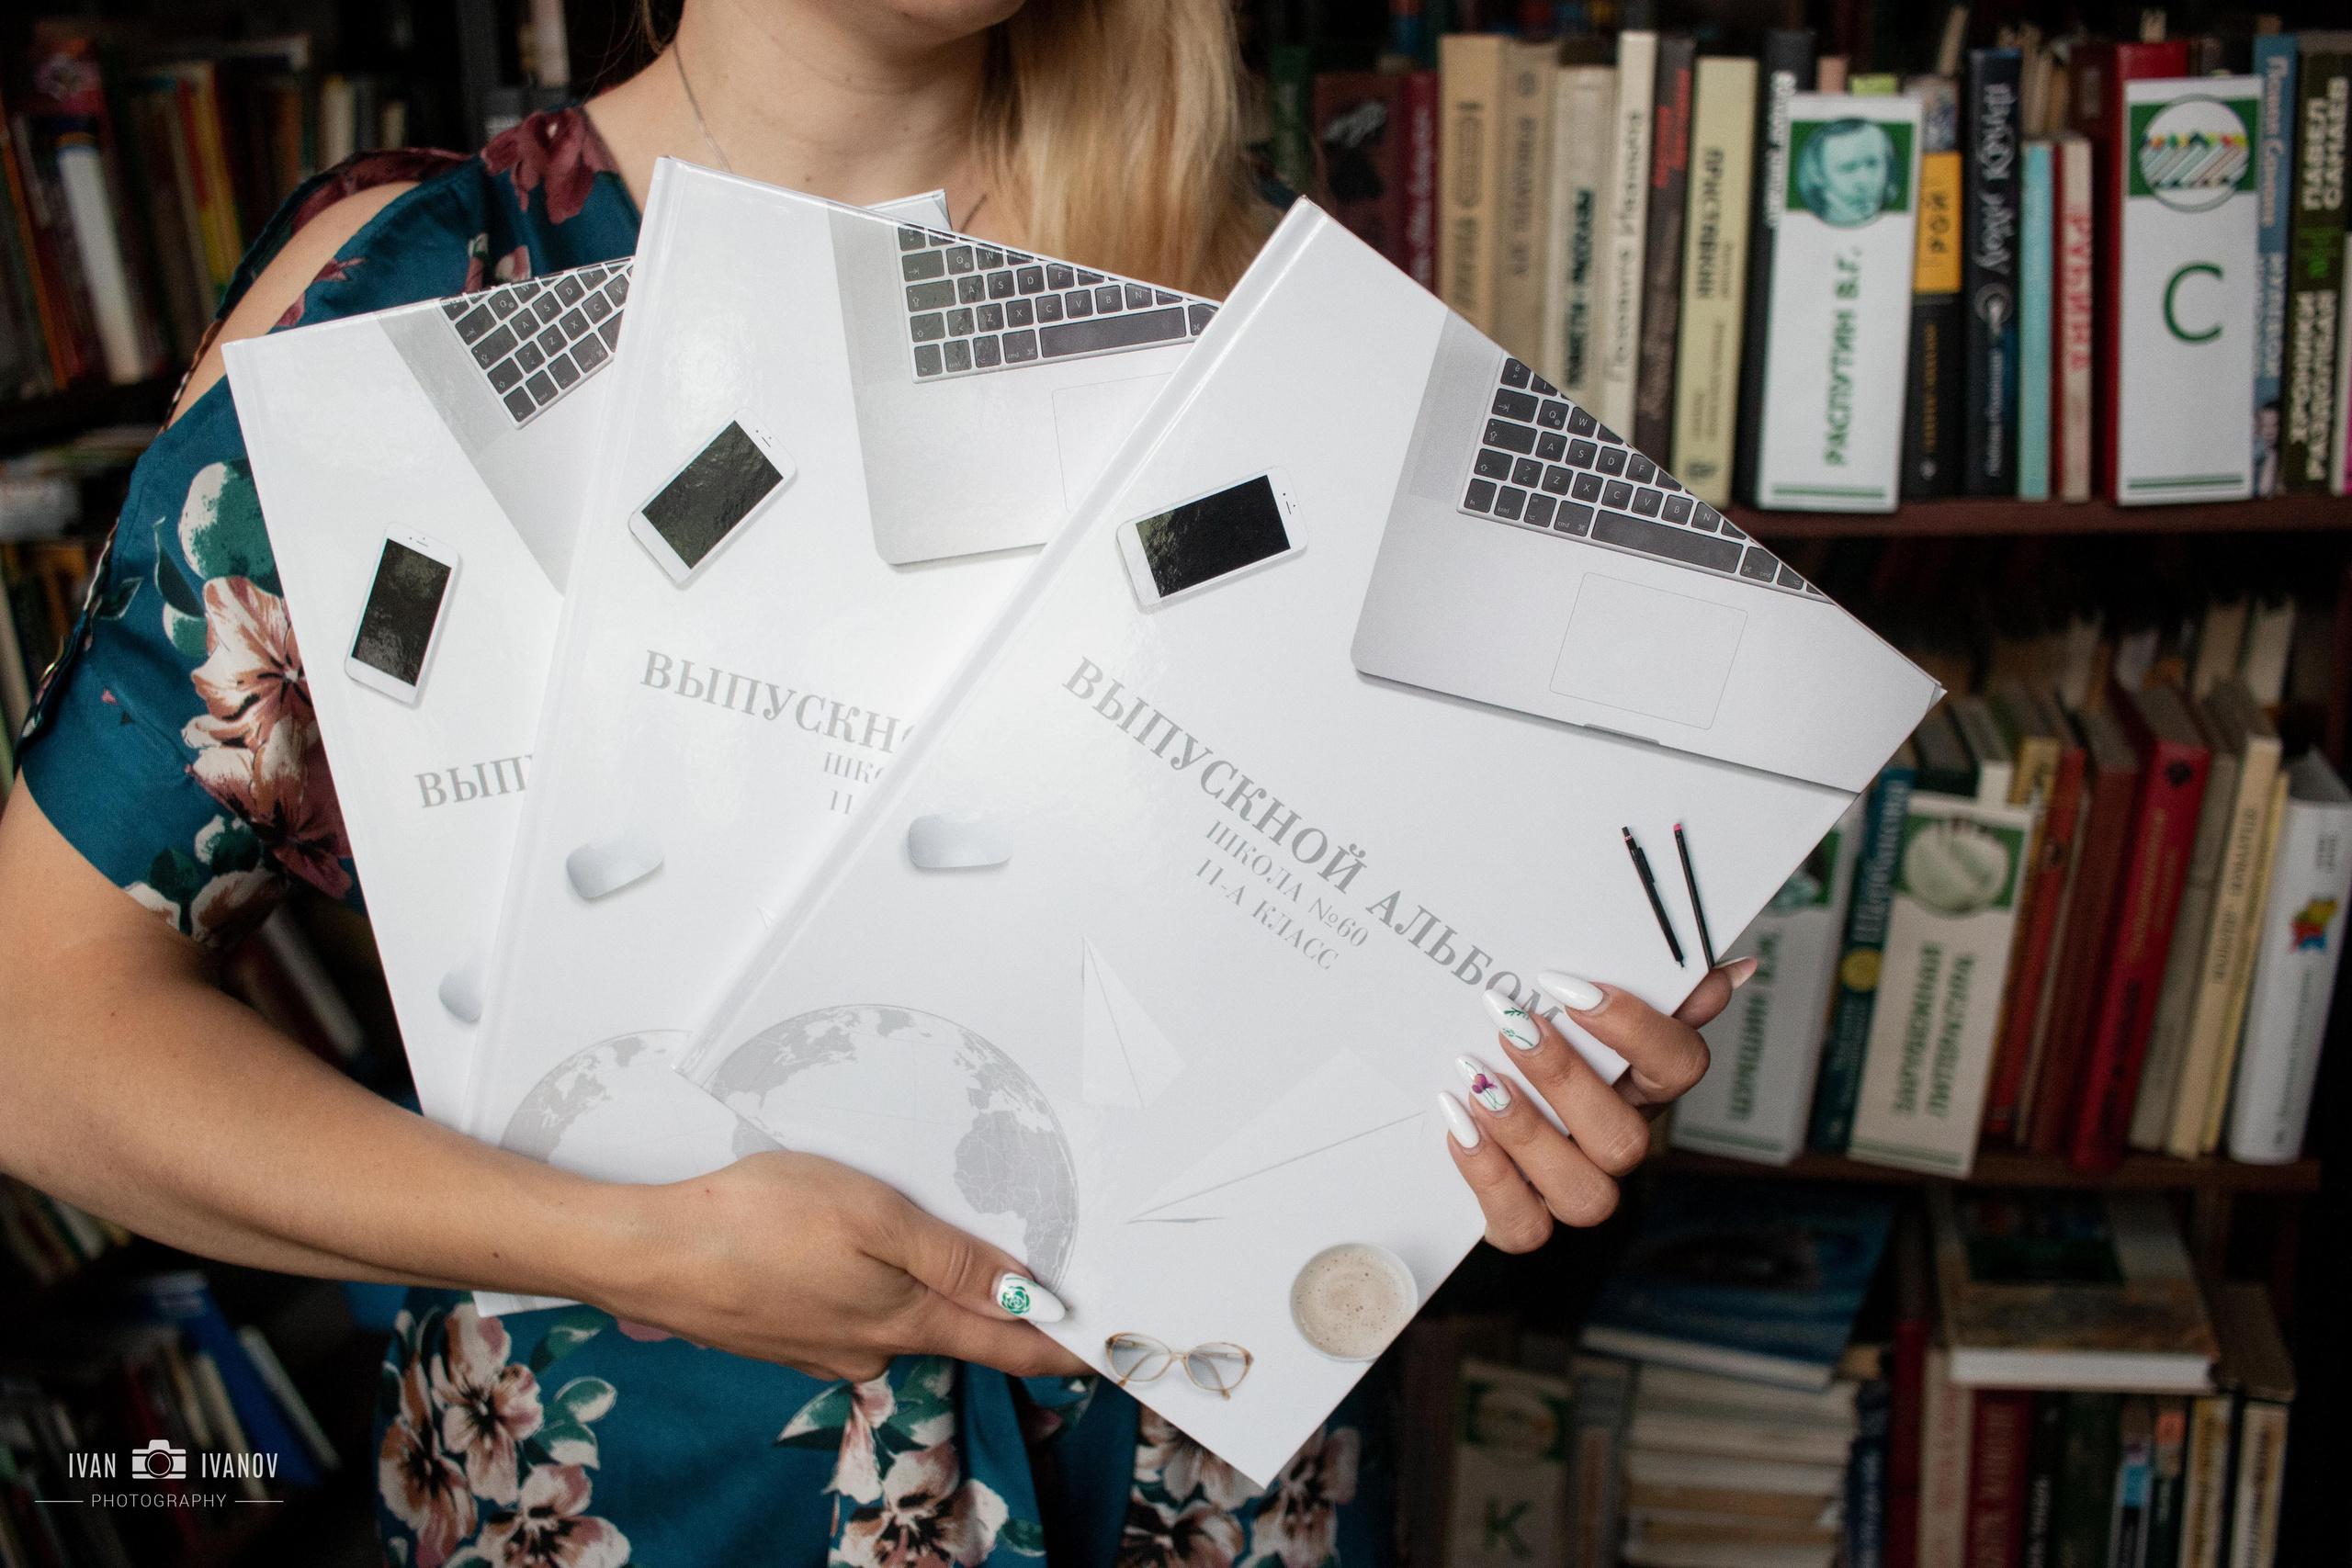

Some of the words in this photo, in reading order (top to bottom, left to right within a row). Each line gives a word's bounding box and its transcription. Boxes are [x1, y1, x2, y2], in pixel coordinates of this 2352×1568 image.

[2303, 97, 2327, 210] ПАВЕЛ
[1696, 146, 1724, 301] ПРИСТАВКИН
[1836, 247, 1863, 299] В.Г.
[2164, 261, 2223, 344] С
[1826, 309, 1856, 466] РАСПУТИН
[2290, 290, 2317, 445] ХРОНИКИ
[2306, 290, 2337, 481] РАЗДОЛБАЯ
[640, 650, 915, 753] ВЫПУСКН
[414, 754, 533, 808] ВЫП
[823, 752, 884, 784] ШК
[1062, 657, 1368, 896] ВЫПУСКНОЙ
[1205, 820, 1302, 904] ШКОЛА
[1308, 897, 1369, 947] №60
[1252, 900, 1340, 970] КЛАСС
[1924, 954, 1977, 1120] ЛИТЕРАТУРА
